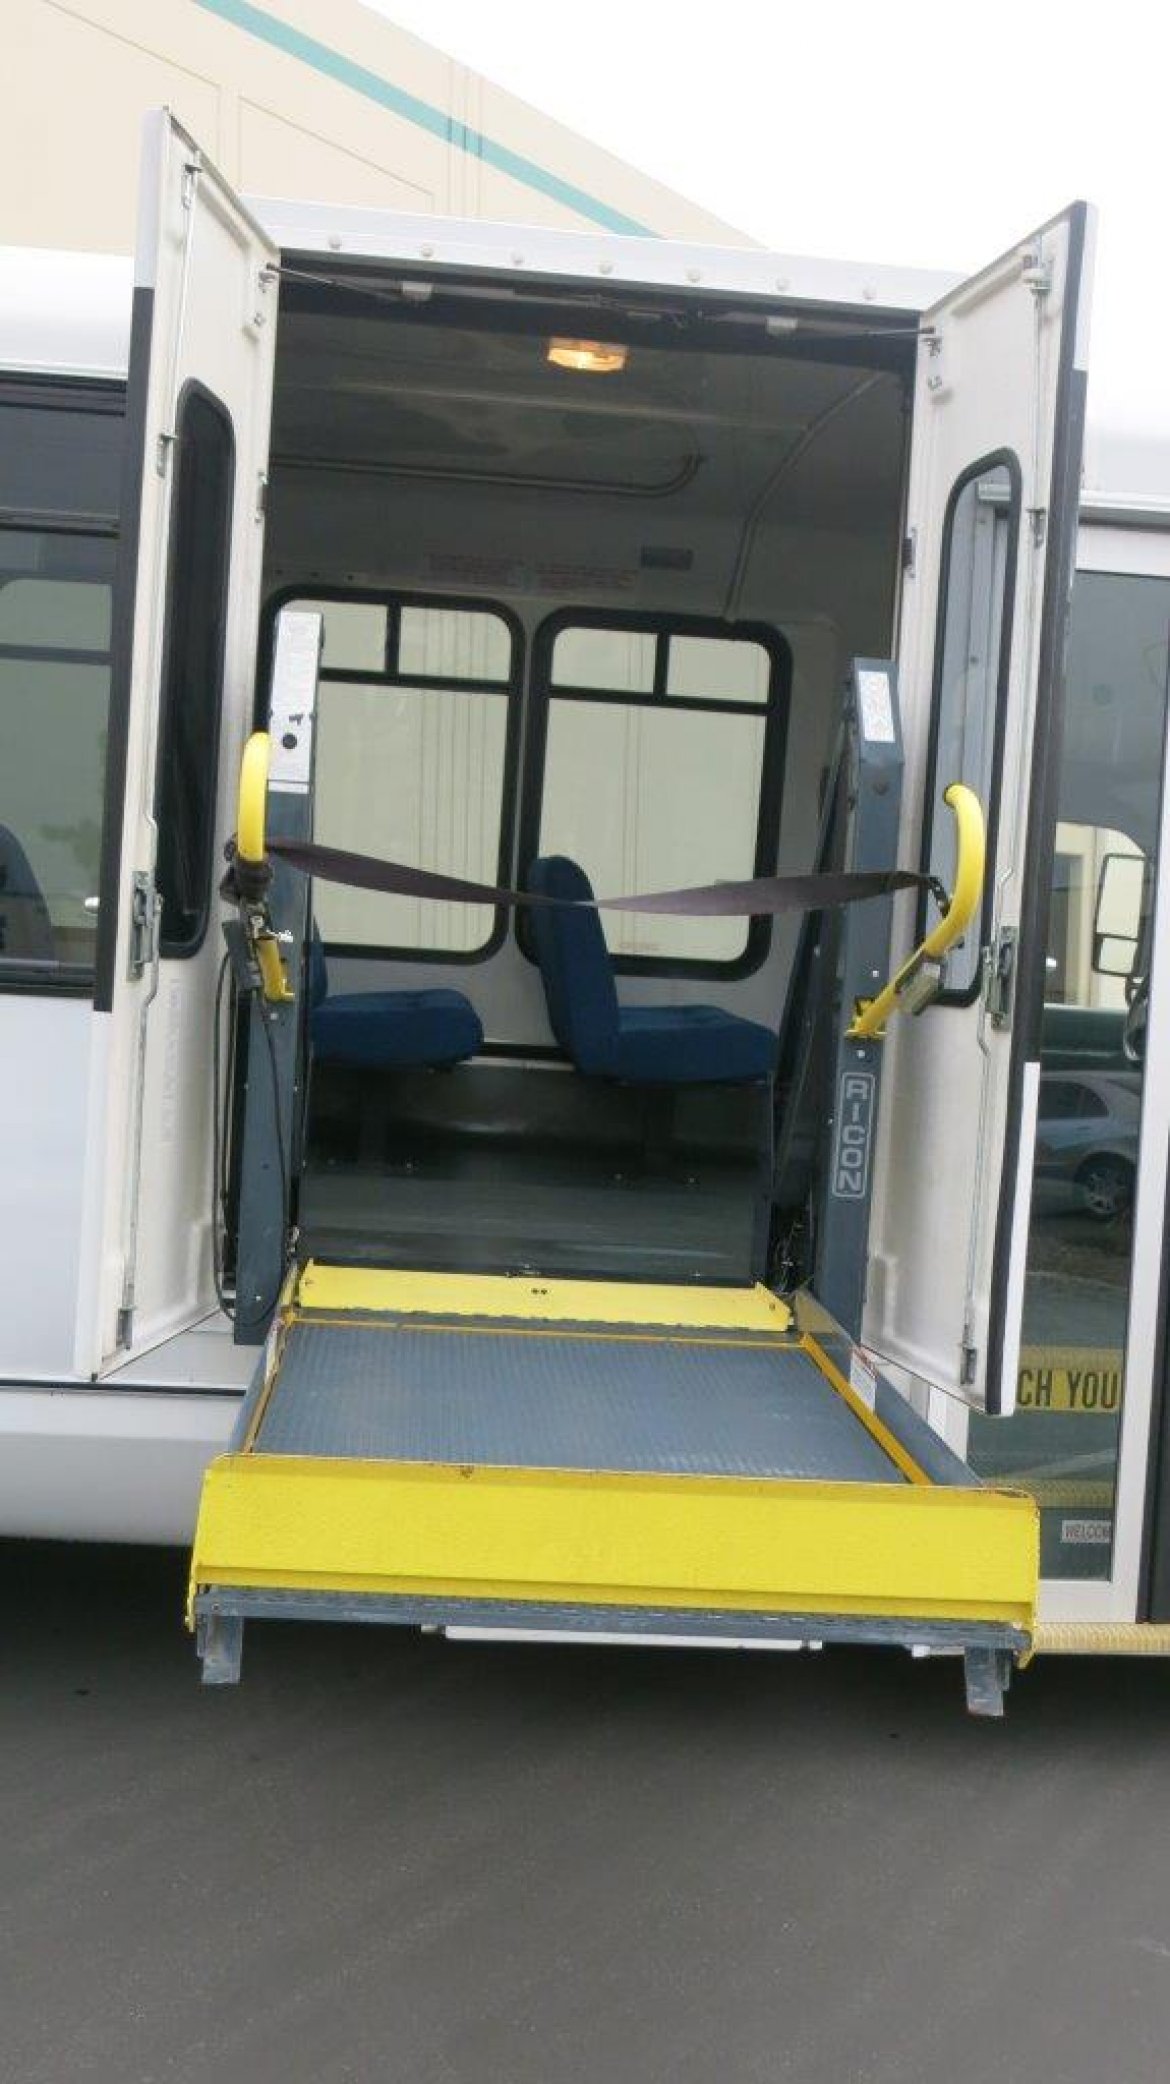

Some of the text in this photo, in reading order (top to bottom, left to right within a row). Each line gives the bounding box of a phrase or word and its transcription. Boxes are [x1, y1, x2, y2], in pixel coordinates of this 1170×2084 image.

[838, 1079, 868, 1191] RICON
[1017, 1369, 1118, 1409] CH YOU
